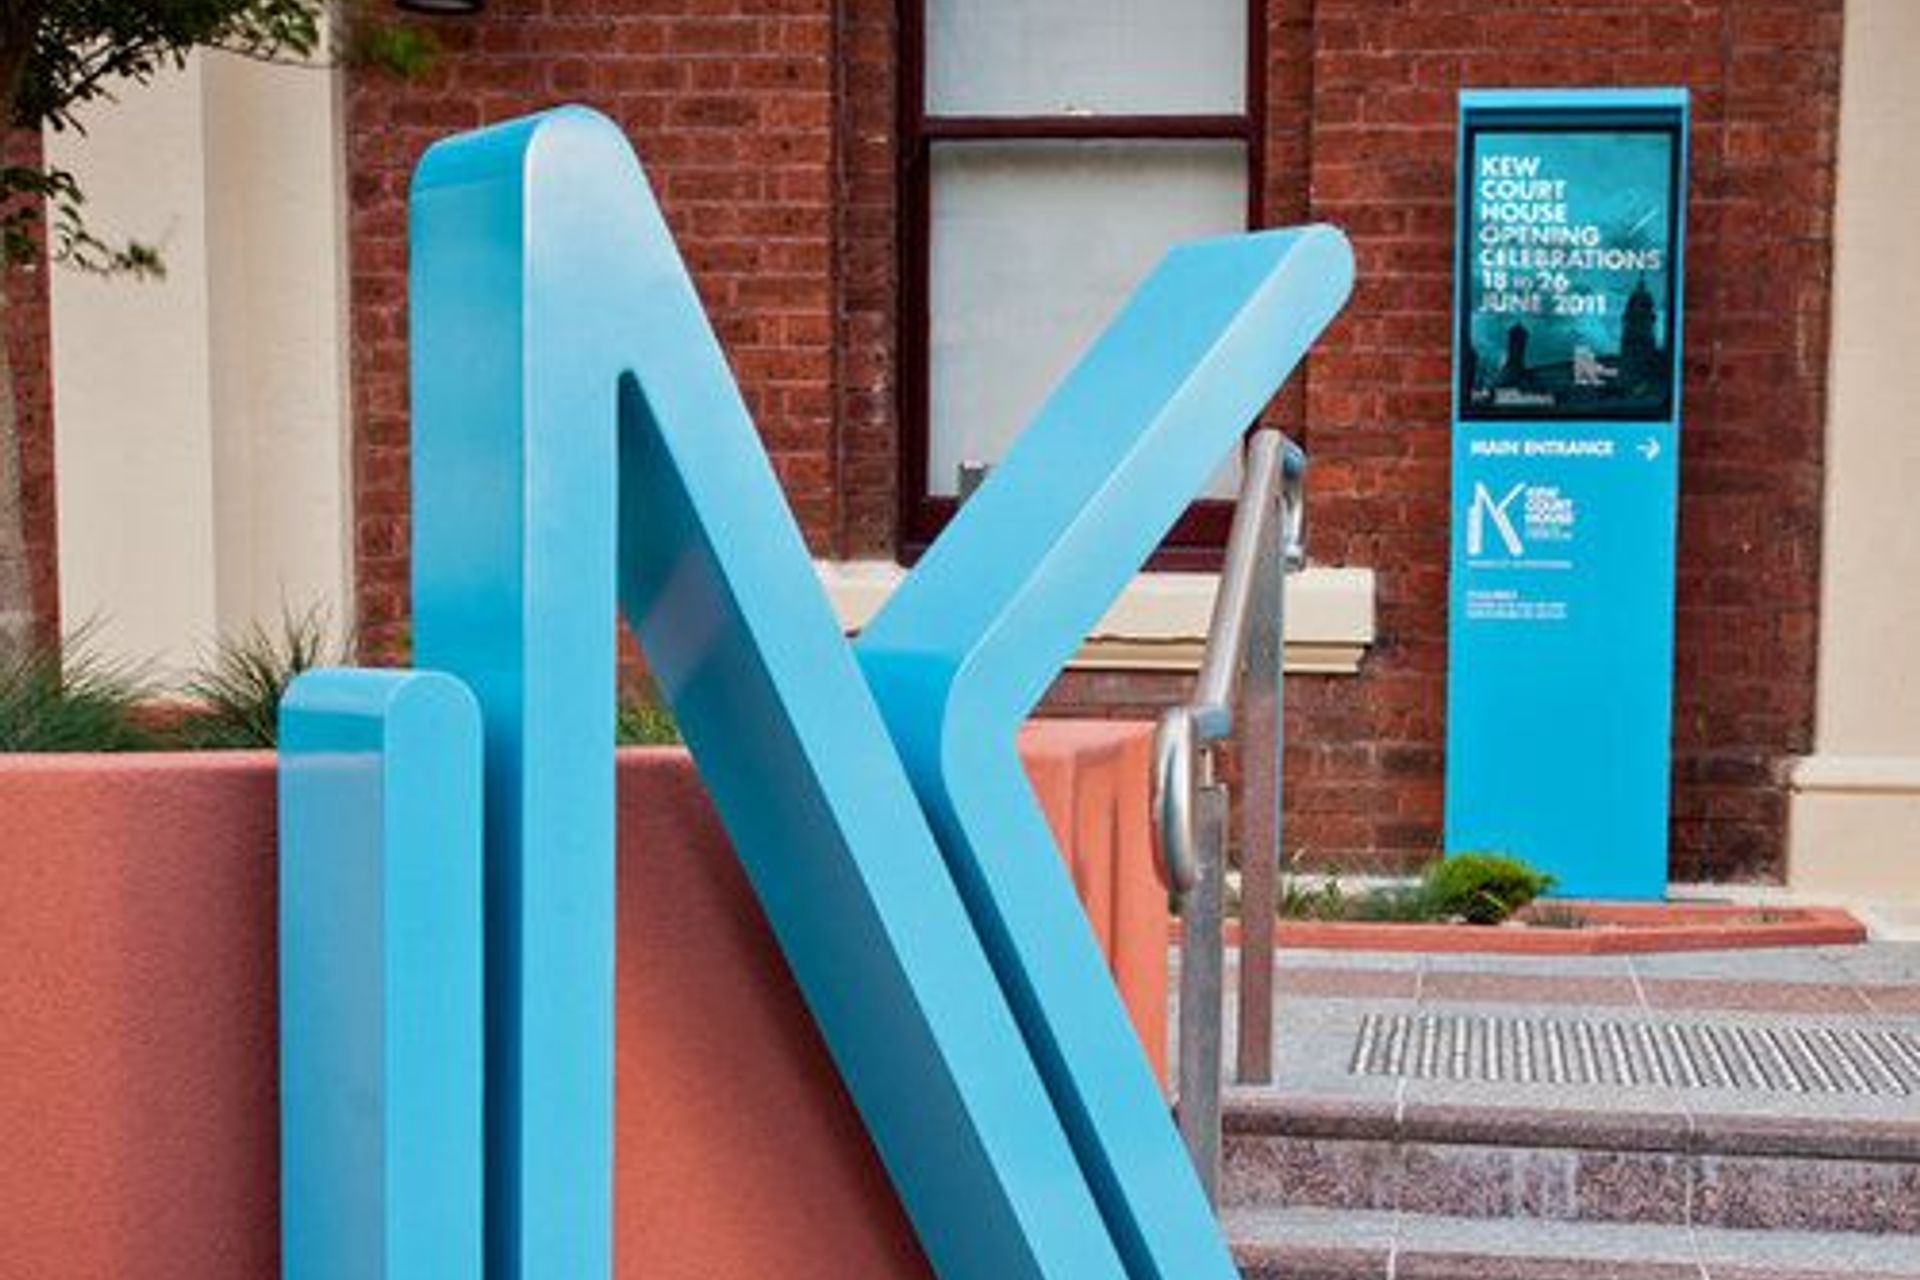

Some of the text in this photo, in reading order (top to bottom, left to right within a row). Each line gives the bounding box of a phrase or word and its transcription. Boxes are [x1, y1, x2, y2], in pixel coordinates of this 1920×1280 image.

[1481, 156, 1541, 177] KEW
[1481, 180, 1567, 200] COURT
[1481, 203, 1567, 223] HOUSE
[1480, 225, 1600, 246] OPENING
[1480, 249, 1660, 270] CELEBRATIONS
[1483, 271, 1507, 290] 18
[1536, 272, 1569, 293] 26
[1479, 293, 1607, 315] JUNE 2011
[1470, 440, 1615, 456] MAIN ENTRANCE
